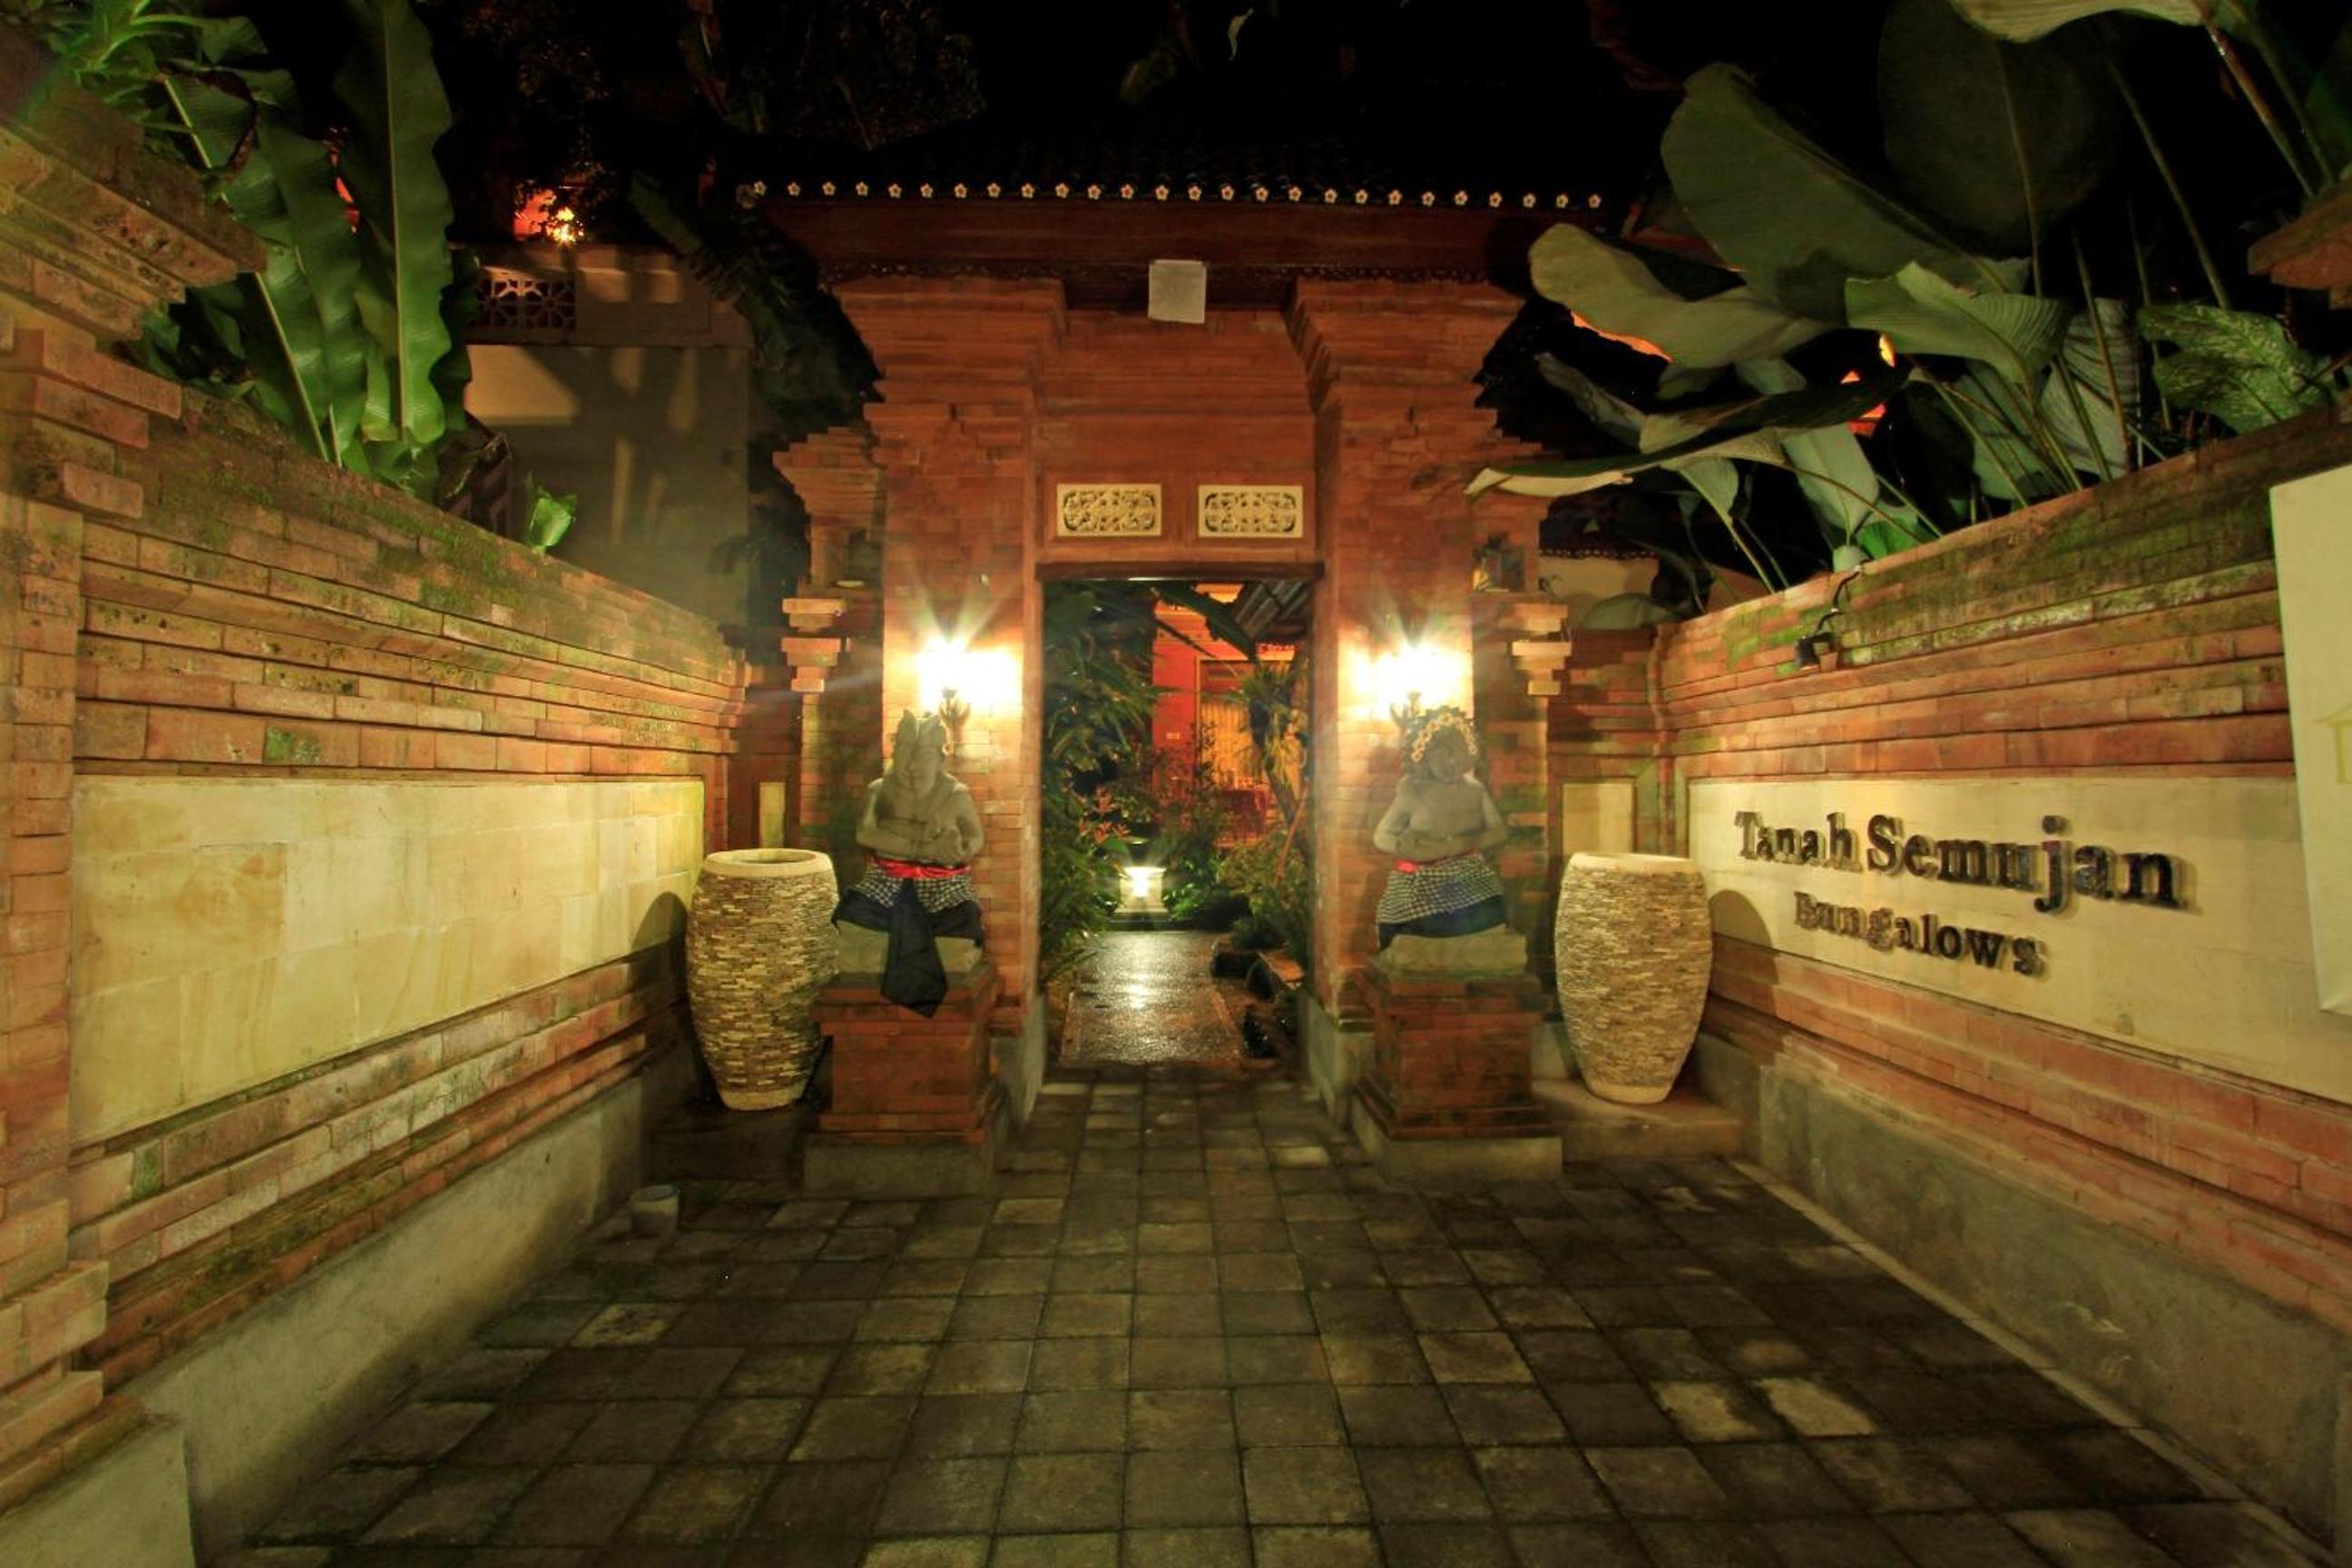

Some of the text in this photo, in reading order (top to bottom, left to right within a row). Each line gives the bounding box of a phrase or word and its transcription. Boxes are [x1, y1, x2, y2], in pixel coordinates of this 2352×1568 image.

[1735, 811, 2189, 913] Tanah Semujan
[1793, 890, 2044, 976] Bungalows
